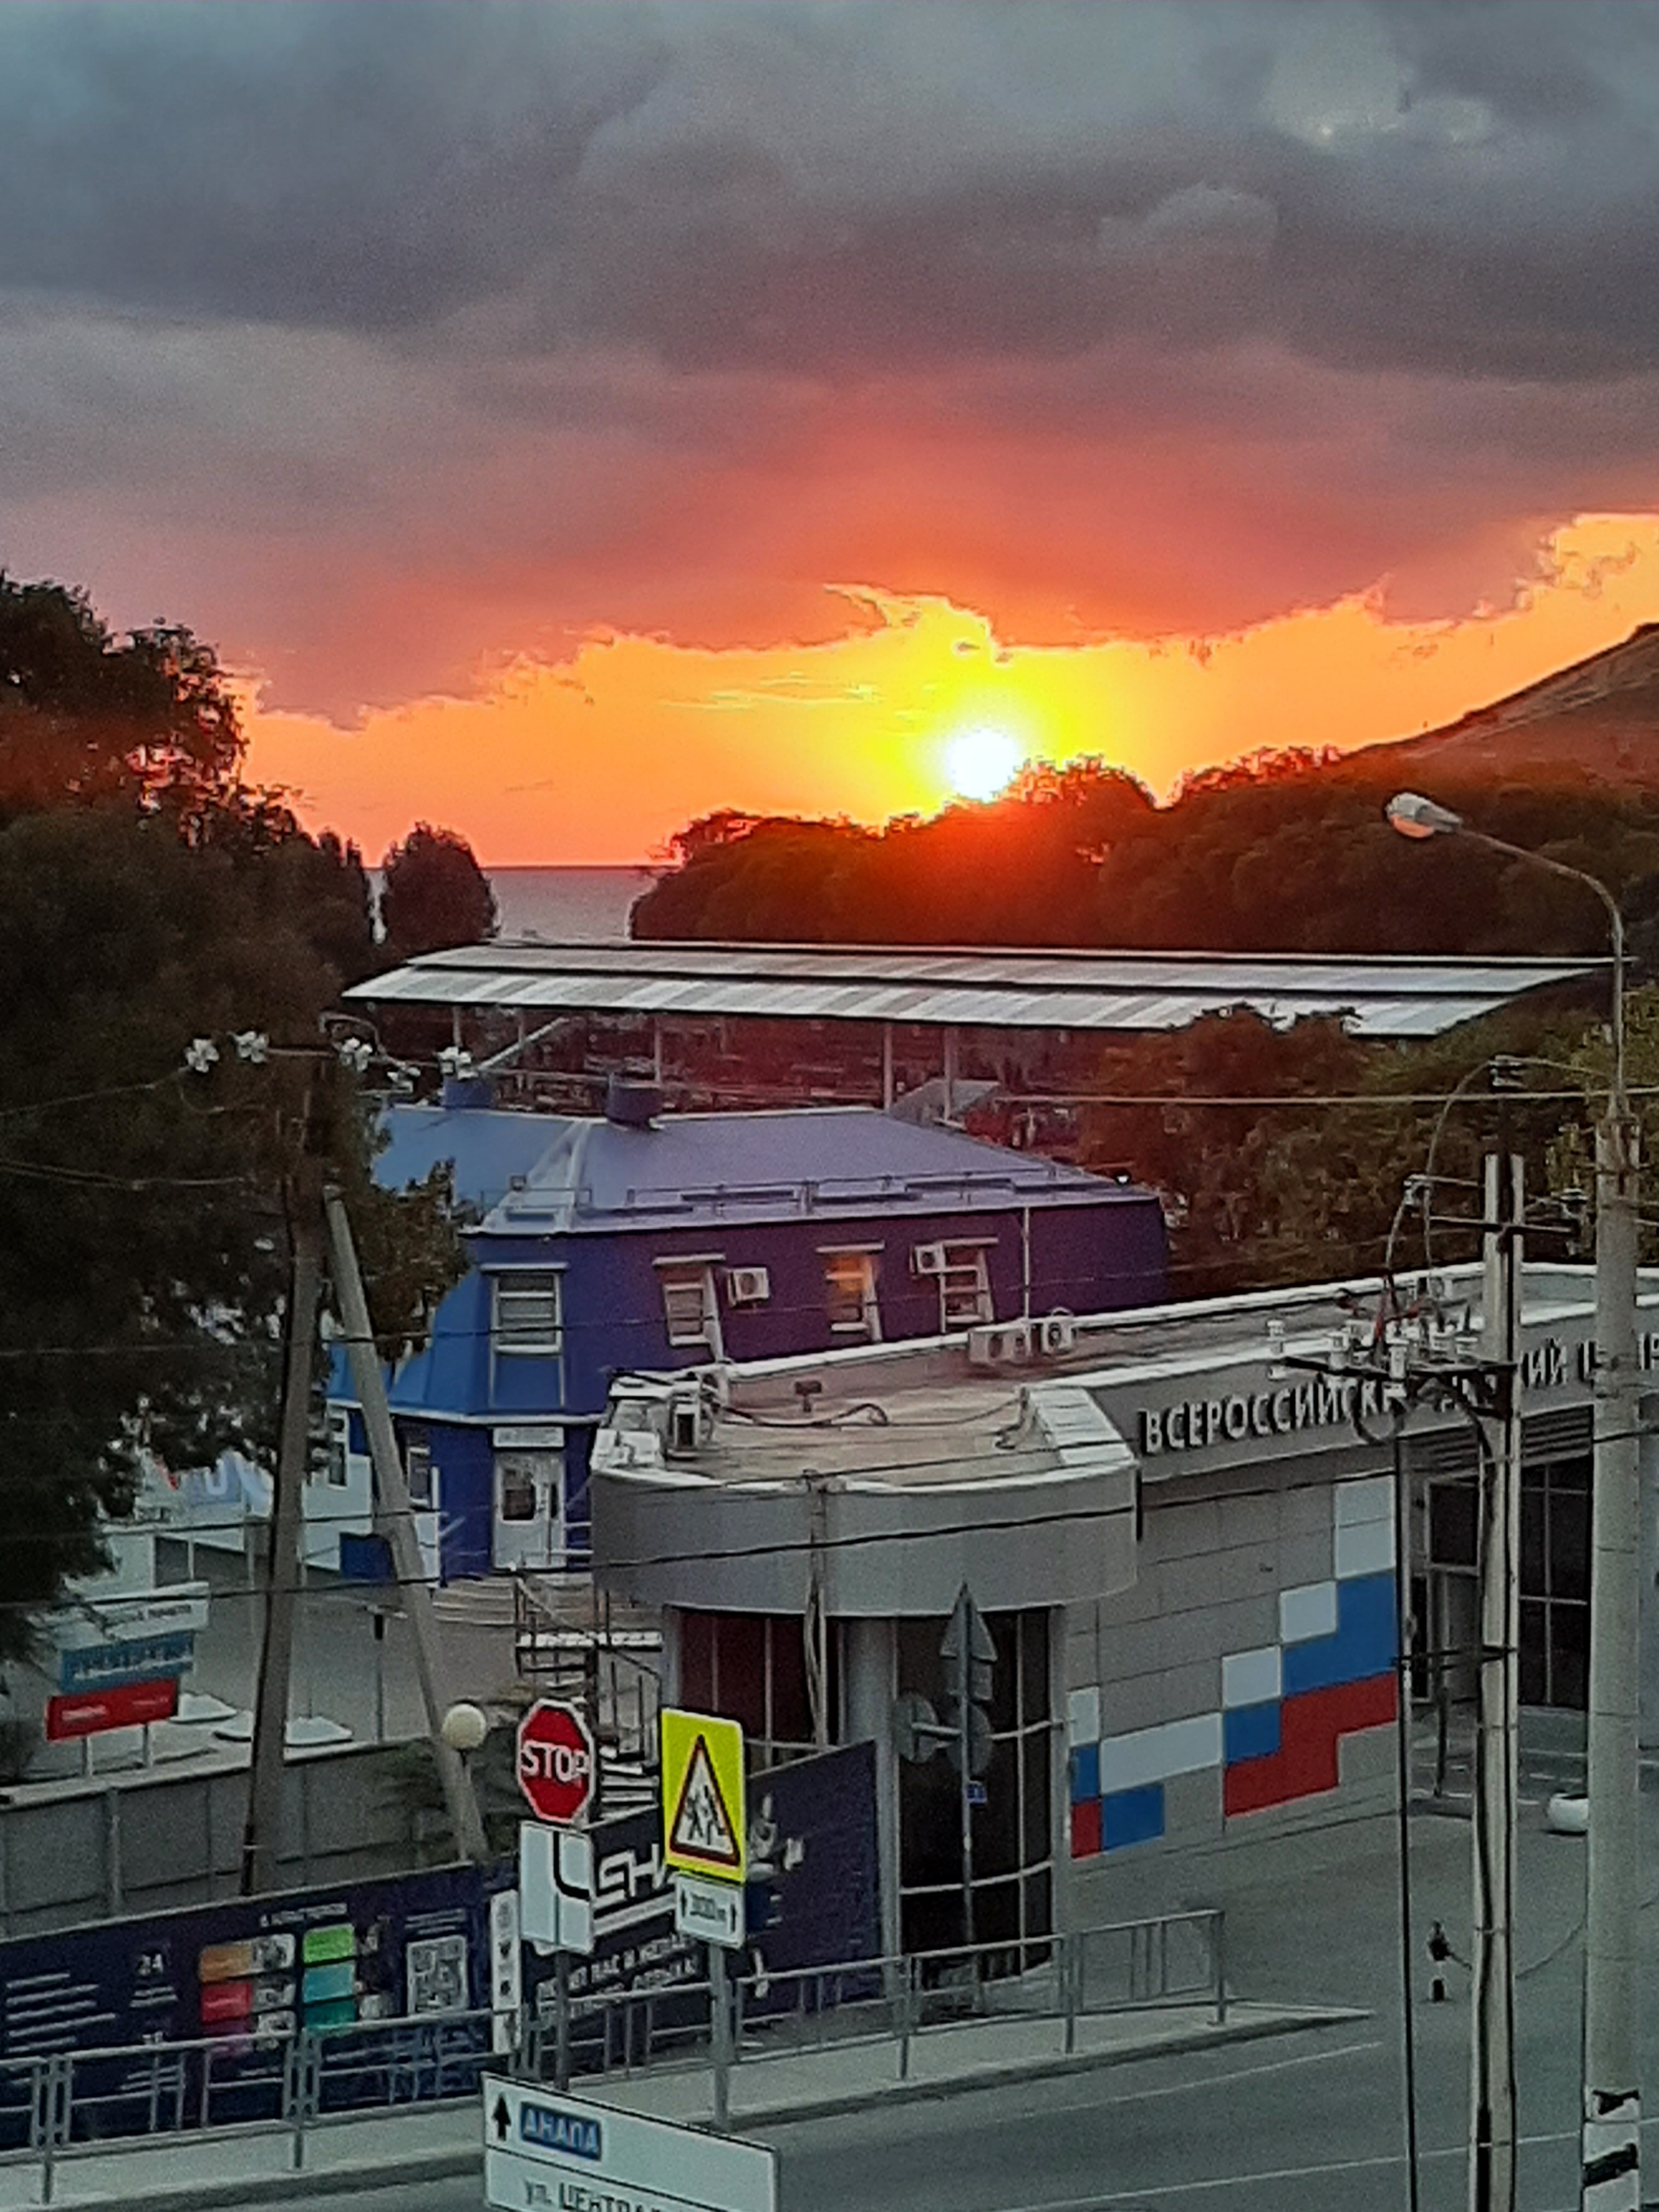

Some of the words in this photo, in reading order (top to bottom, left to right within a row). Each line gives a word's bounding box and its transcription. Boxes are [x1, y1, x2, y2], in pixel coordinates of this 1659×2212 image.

[1144, 1376, 1404, 1454] ВСЕРОССИЙСК
[521, 1740, 589, 1787] STOP
[524, 2108, 599, 2153] АНАПА
